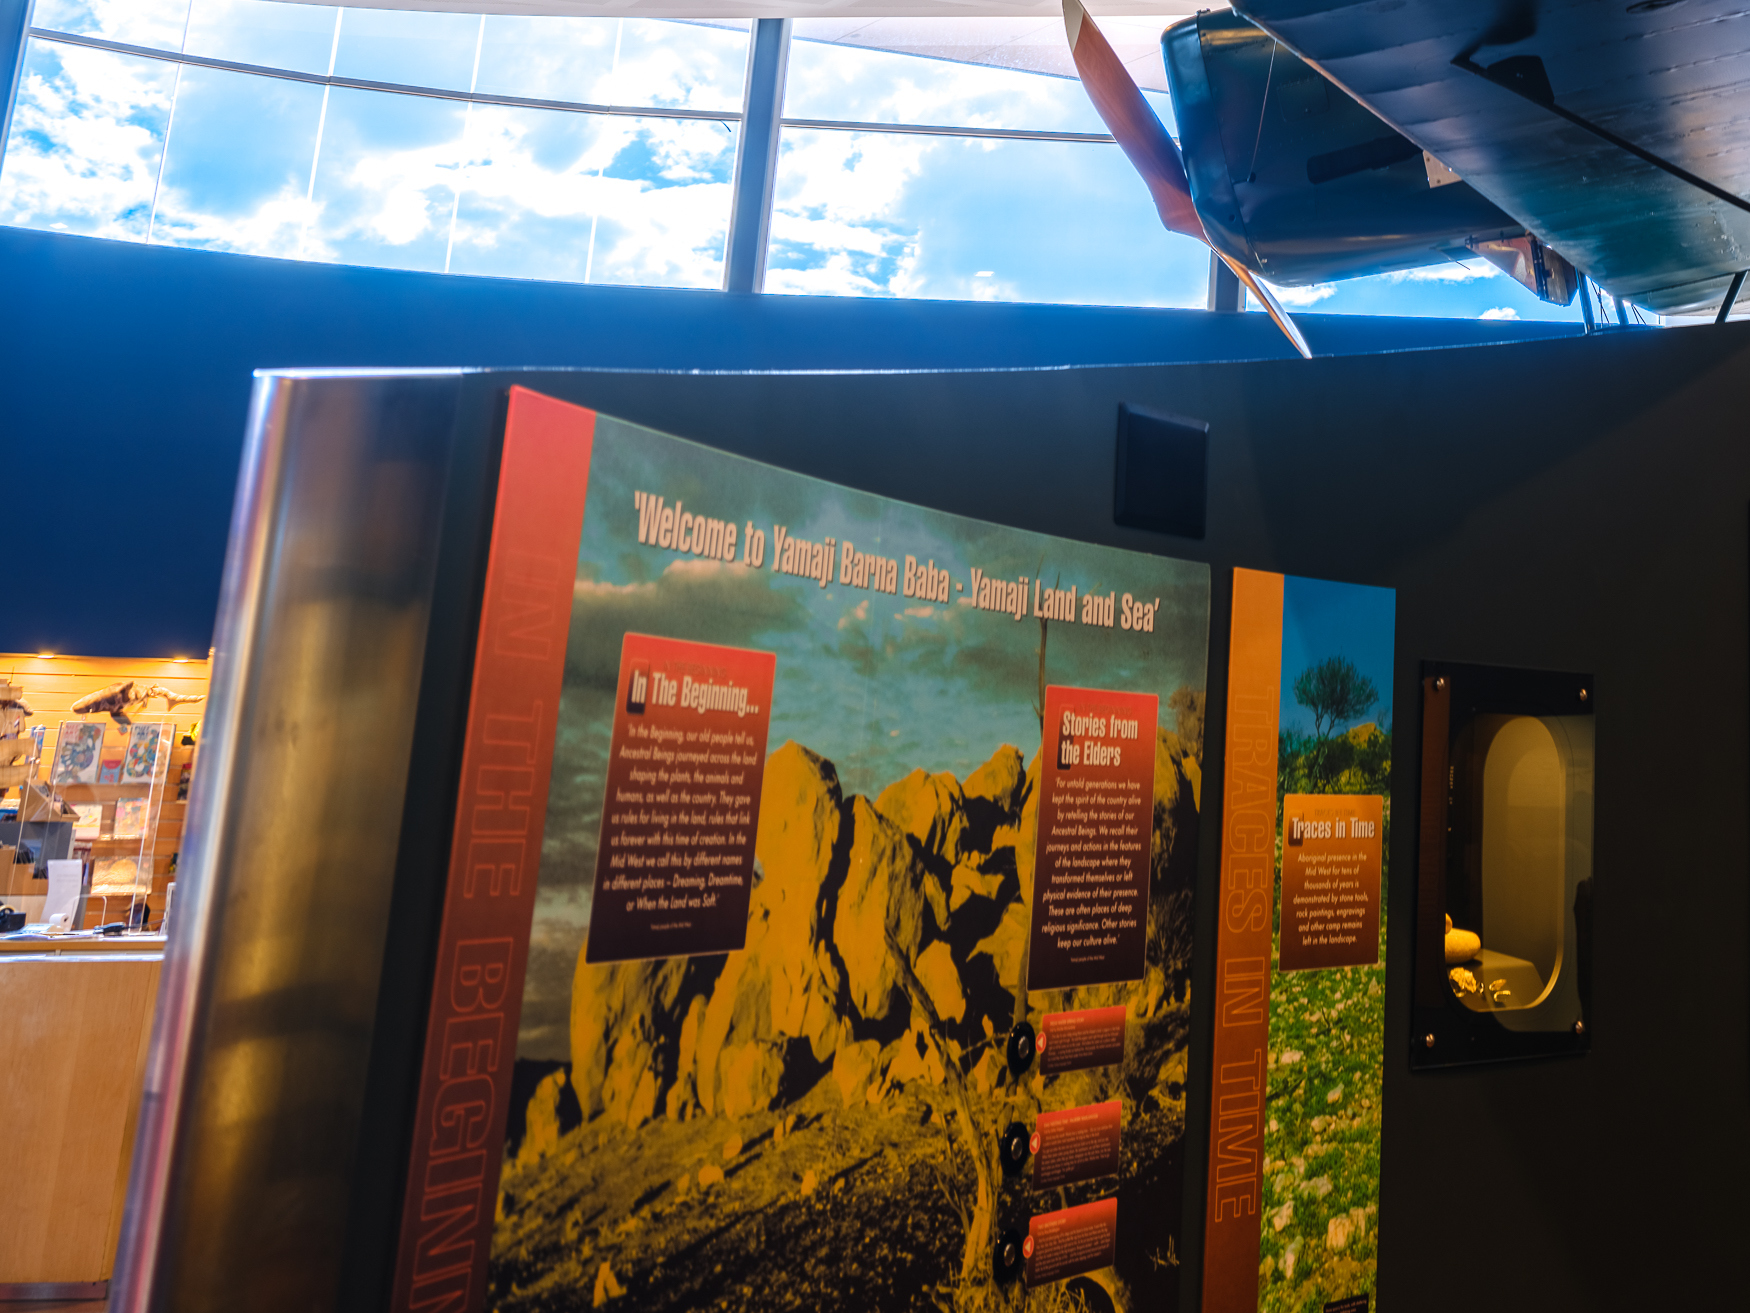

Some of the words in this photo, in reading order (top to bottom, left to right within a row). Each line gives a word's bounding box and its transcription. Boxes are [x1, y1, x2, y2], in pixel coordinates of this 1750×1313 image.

[635, 490, 737, 562] 'Welcome
[744, 521, 764, 568] to
[772, 525, 836, 588] Yamaji
[839, 541, 898, 594] Barna
[903, 555, 950, 603] Baba
[971, 567, 1029, 621] Yamaji
[1033, 579, 1077, 622] Land
[1082, 591, 1115, 628] and
[1120, 592, 1160, 632] Sea'
[631, 669, 647, 703] In
[652, 672, 677, 706] The
[680, 675, 759, 717] Beginning...
[638, 723, 648, 738] the
[687, 731, 698, 742] our
[699, 728, 711, 743] old
[711, 731, 733, 746] people
[735, 731, 745, 744] tell
[1063, 710, 1106, 737] Stories
[1110, 715, 1138, 739] from
[619, 745, 652, 760] Ancestral
[653, 746, 674, 765] Beings
[676, 749, 709, 765] journeyed
[710, 753, 729, 764] across
[731, 751, 741, 765] the
[742, 753, 757, 765] land
[1062, 740, 1080, 764] the
[1084, 741, 1121, 766] Elders
[1067, 778, 1084, 788] untold
[1086, 780, 1116, 791] generations
[1128, 779, 1140, 790] have
[464, 698, 544, 899] THE
[1052, 792, 1064, 806] kept
[1065, 792, 1074, 804] the
[1076, 794, 1088, 806] spirit
[1090, 792, 1096, 804] of
[1097, 793, 1106, 804] the
[1107, 796, 1127, 806] country
[1128, 794, 1141, 804] alive
[1226, 686, 1274, 933] TRACES
[1292, 817, 1331, 839] Traces
[1335, 817, 1345, 838] in
[1350, 817, 1375, 838] Time
[1298, 852, 1326, 865] Aboriginal
[1327, 854, 1351, 864] presence
[1352, 852, 1357, 861] in
[1359, 851, 1367, 861] the
[1305, 866, 1316, 876] Mid
[1318, 865, 1331, 875] West
[1341, 867, 1352, 875] tens
[1353, 864, 1359, 874] of
[1304, 880, 1331, 890] thousands
[1332, 878, 1338, 888] of
[1339, 881, 1353, 891] years
[1293, 893, 1330, 905] demonstrated
[1331, 892, 1338, 905] by
[1340, 894, 1353, 902] stone
[1296, 908, 1308, 918] rock
[1336, 907, 1365, 918] engravings
[1299, 921, 1309, 932] and
[1311, 921, 1325, 931] other
[1326, 923, 1340, 932] camp
[1342, 920, 1362, 929] remains
[1303, 935, 1311, 946] left
[1313, 936, 1317, 945] in
[1319, 934, 1327, 944] the
[1223, 957, 1265, 1027] IN
[1205, 1049, 1261, 1222] TIME
